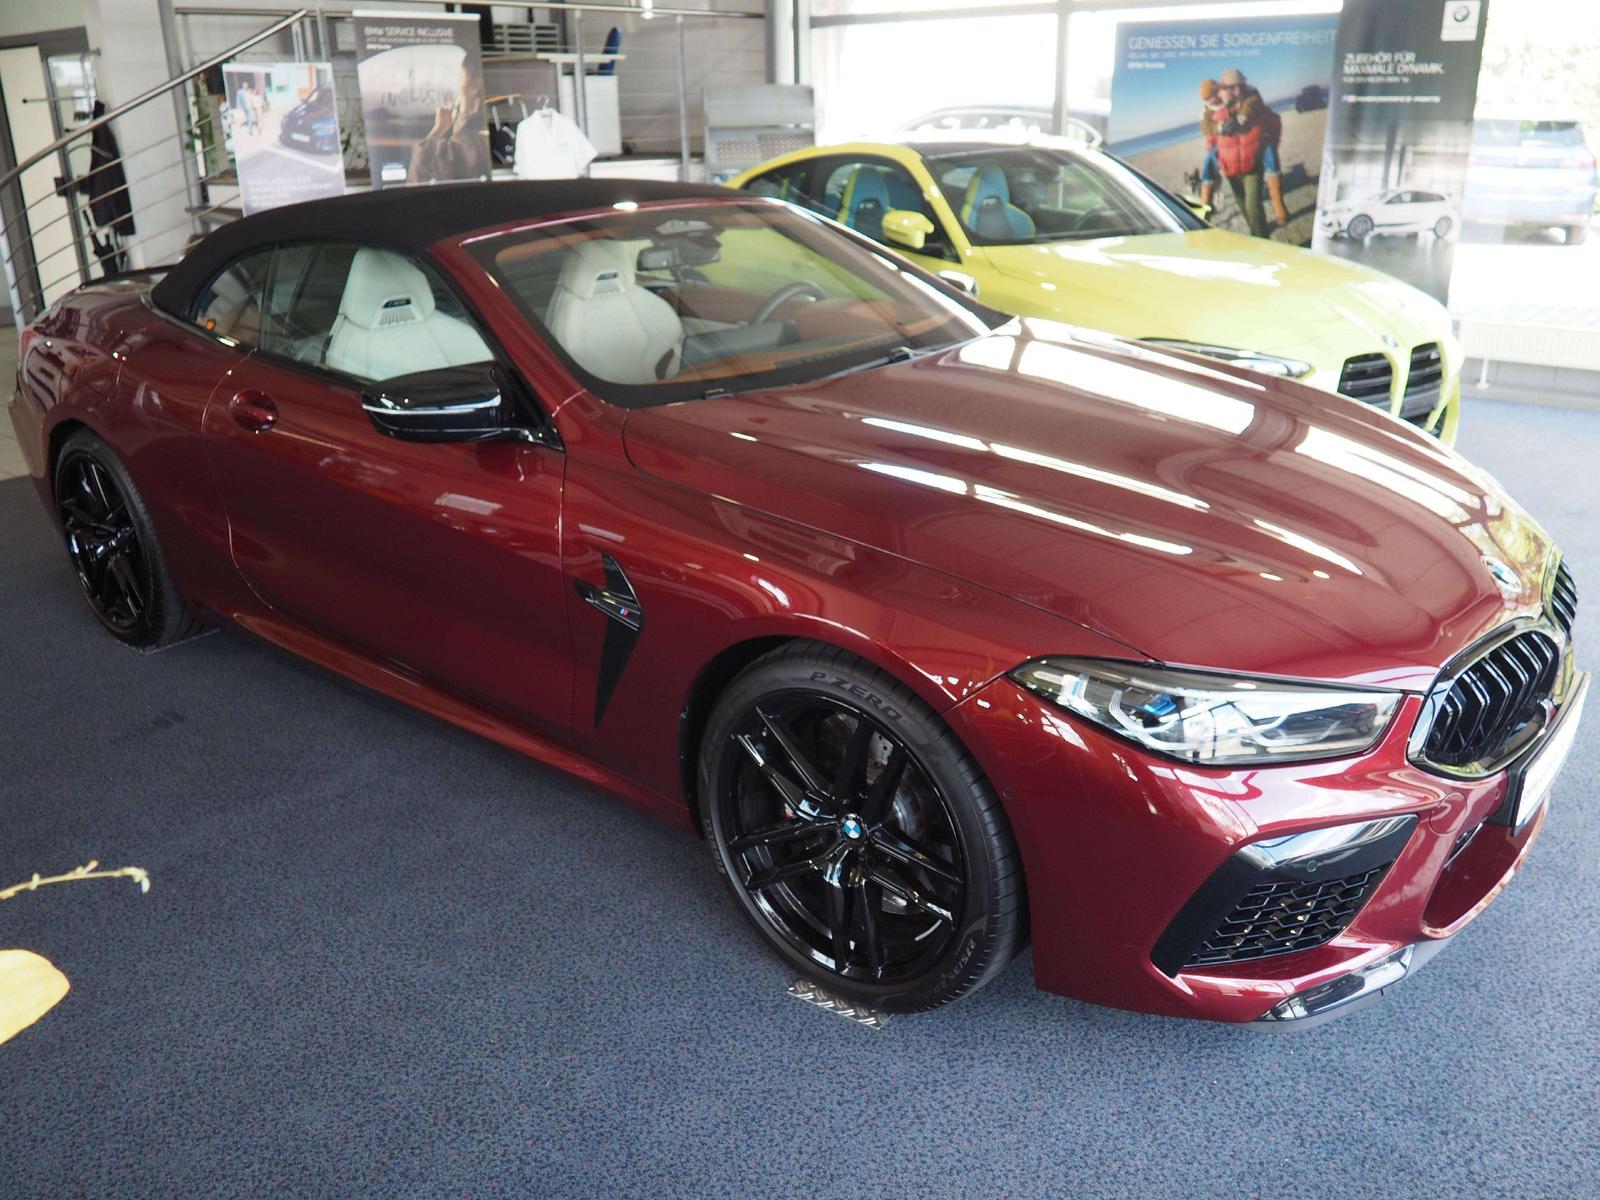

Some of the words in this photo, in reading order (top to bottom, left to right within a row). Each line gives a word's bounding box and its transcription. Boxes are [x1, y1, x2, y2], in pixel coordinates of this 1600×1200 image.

[385, 26, 417, 37] SERVICE
[417, 27, 455, 38] INCLUSIVE
[1128, 34, 1197, 50] GENIESSEN
[1199, 33, 1219, 49] SIE
[1222, 28, 1337, 49] SORGENFREIHEIT
[809, 671, 827, 681] P
[830, 676, 903, 720] ZERO
